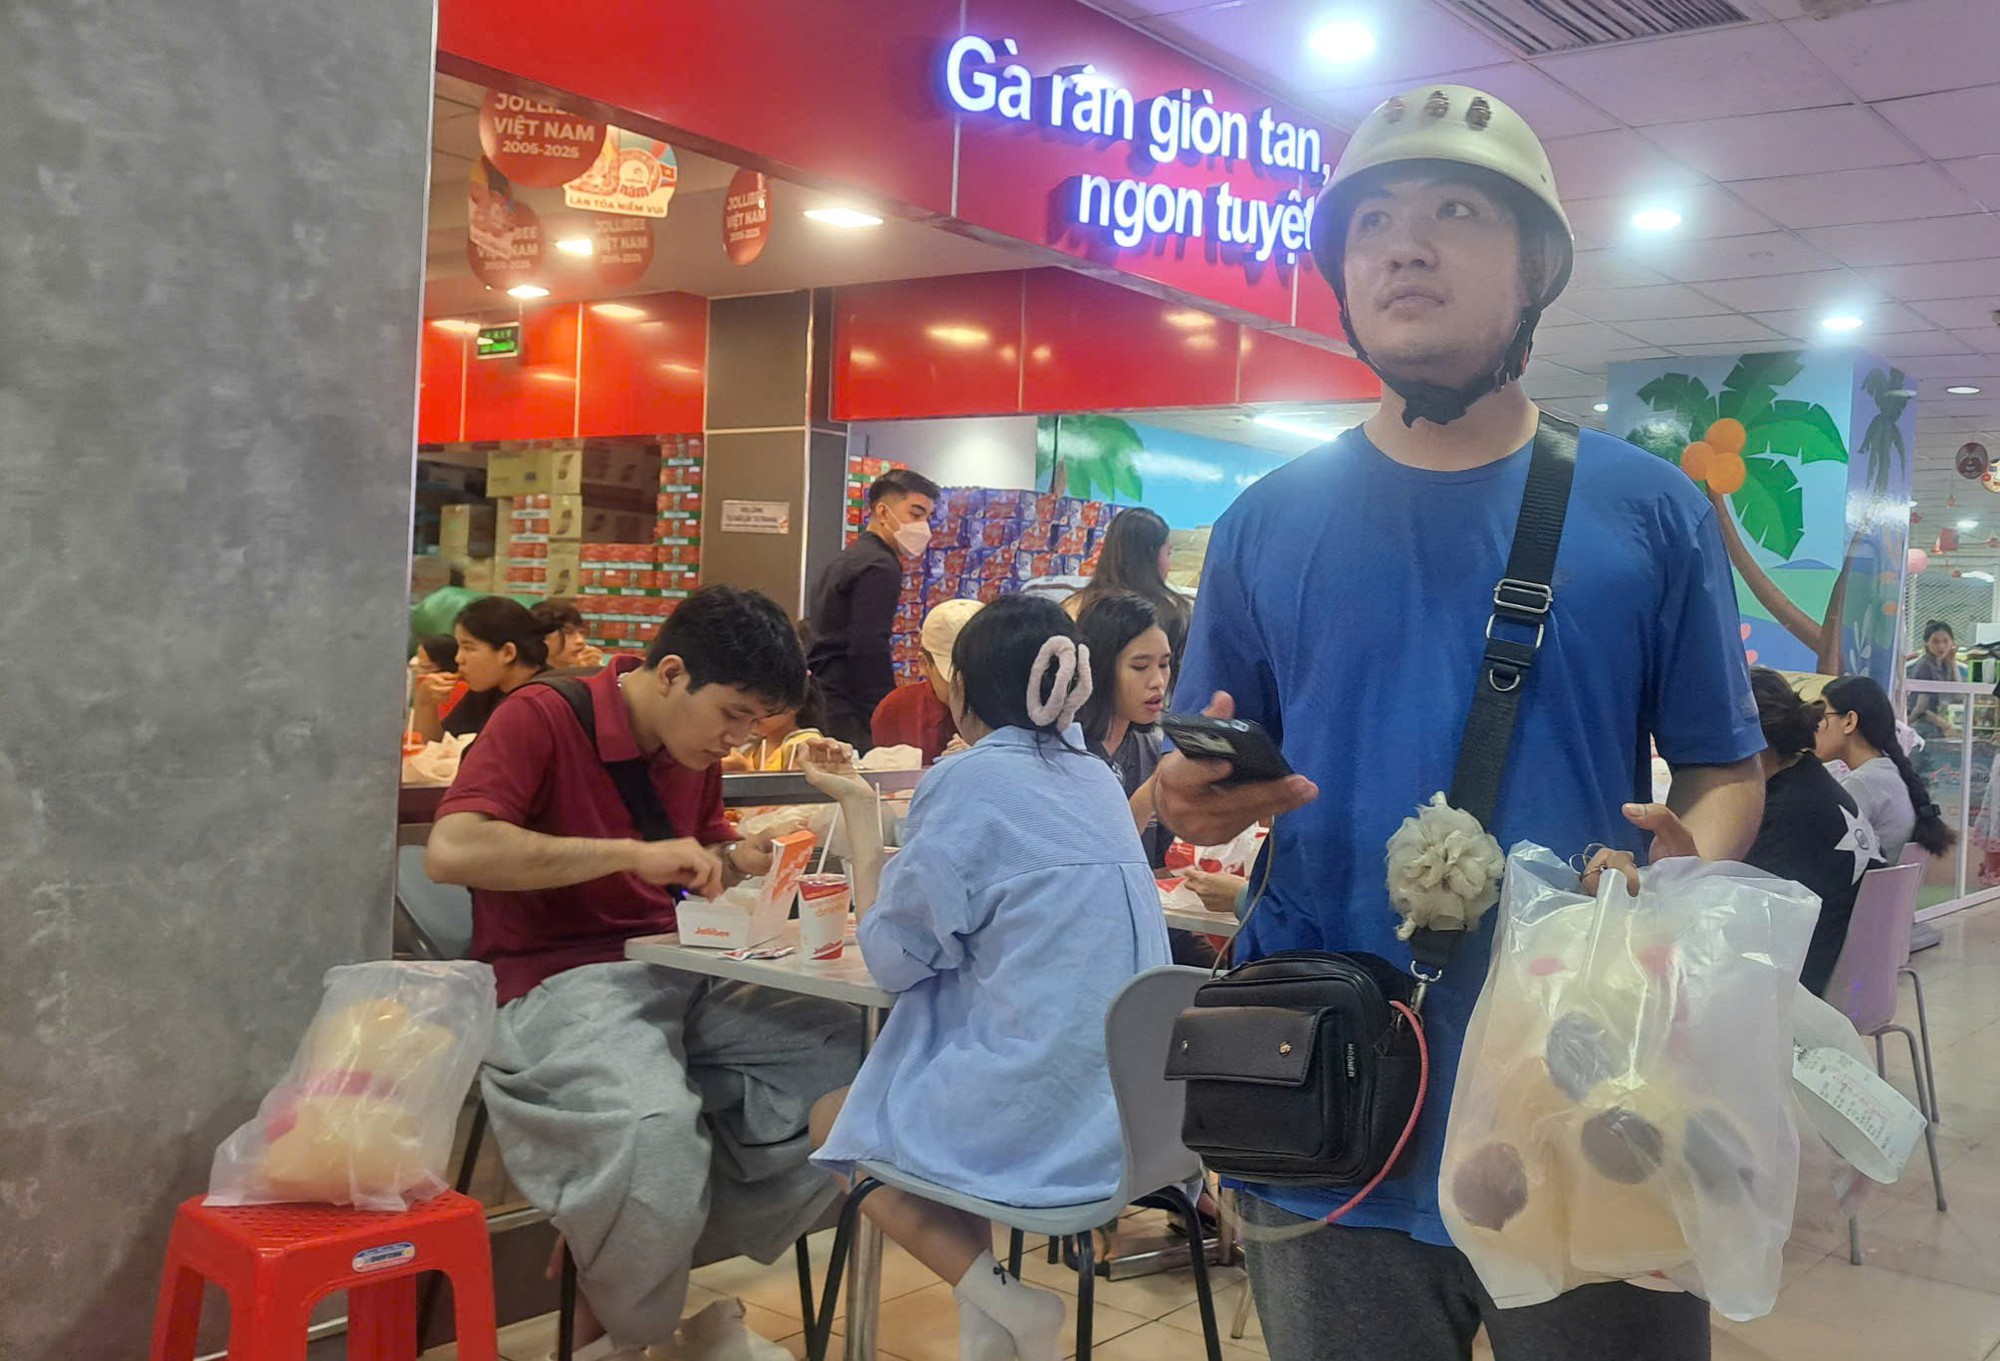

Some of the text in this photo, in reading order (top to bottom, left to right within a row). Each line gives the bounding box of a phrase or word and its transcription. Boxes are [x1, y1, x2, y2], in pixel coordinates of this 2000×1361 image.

[493, 115, 596, 142] VIỆT NAM
[946, 35, 1032, 121] Gà
[1149, 87, 1248, 164] giòn
[1259, 106, 1331, 184] tan,
[1078, 173, 1202, 248] ngon
